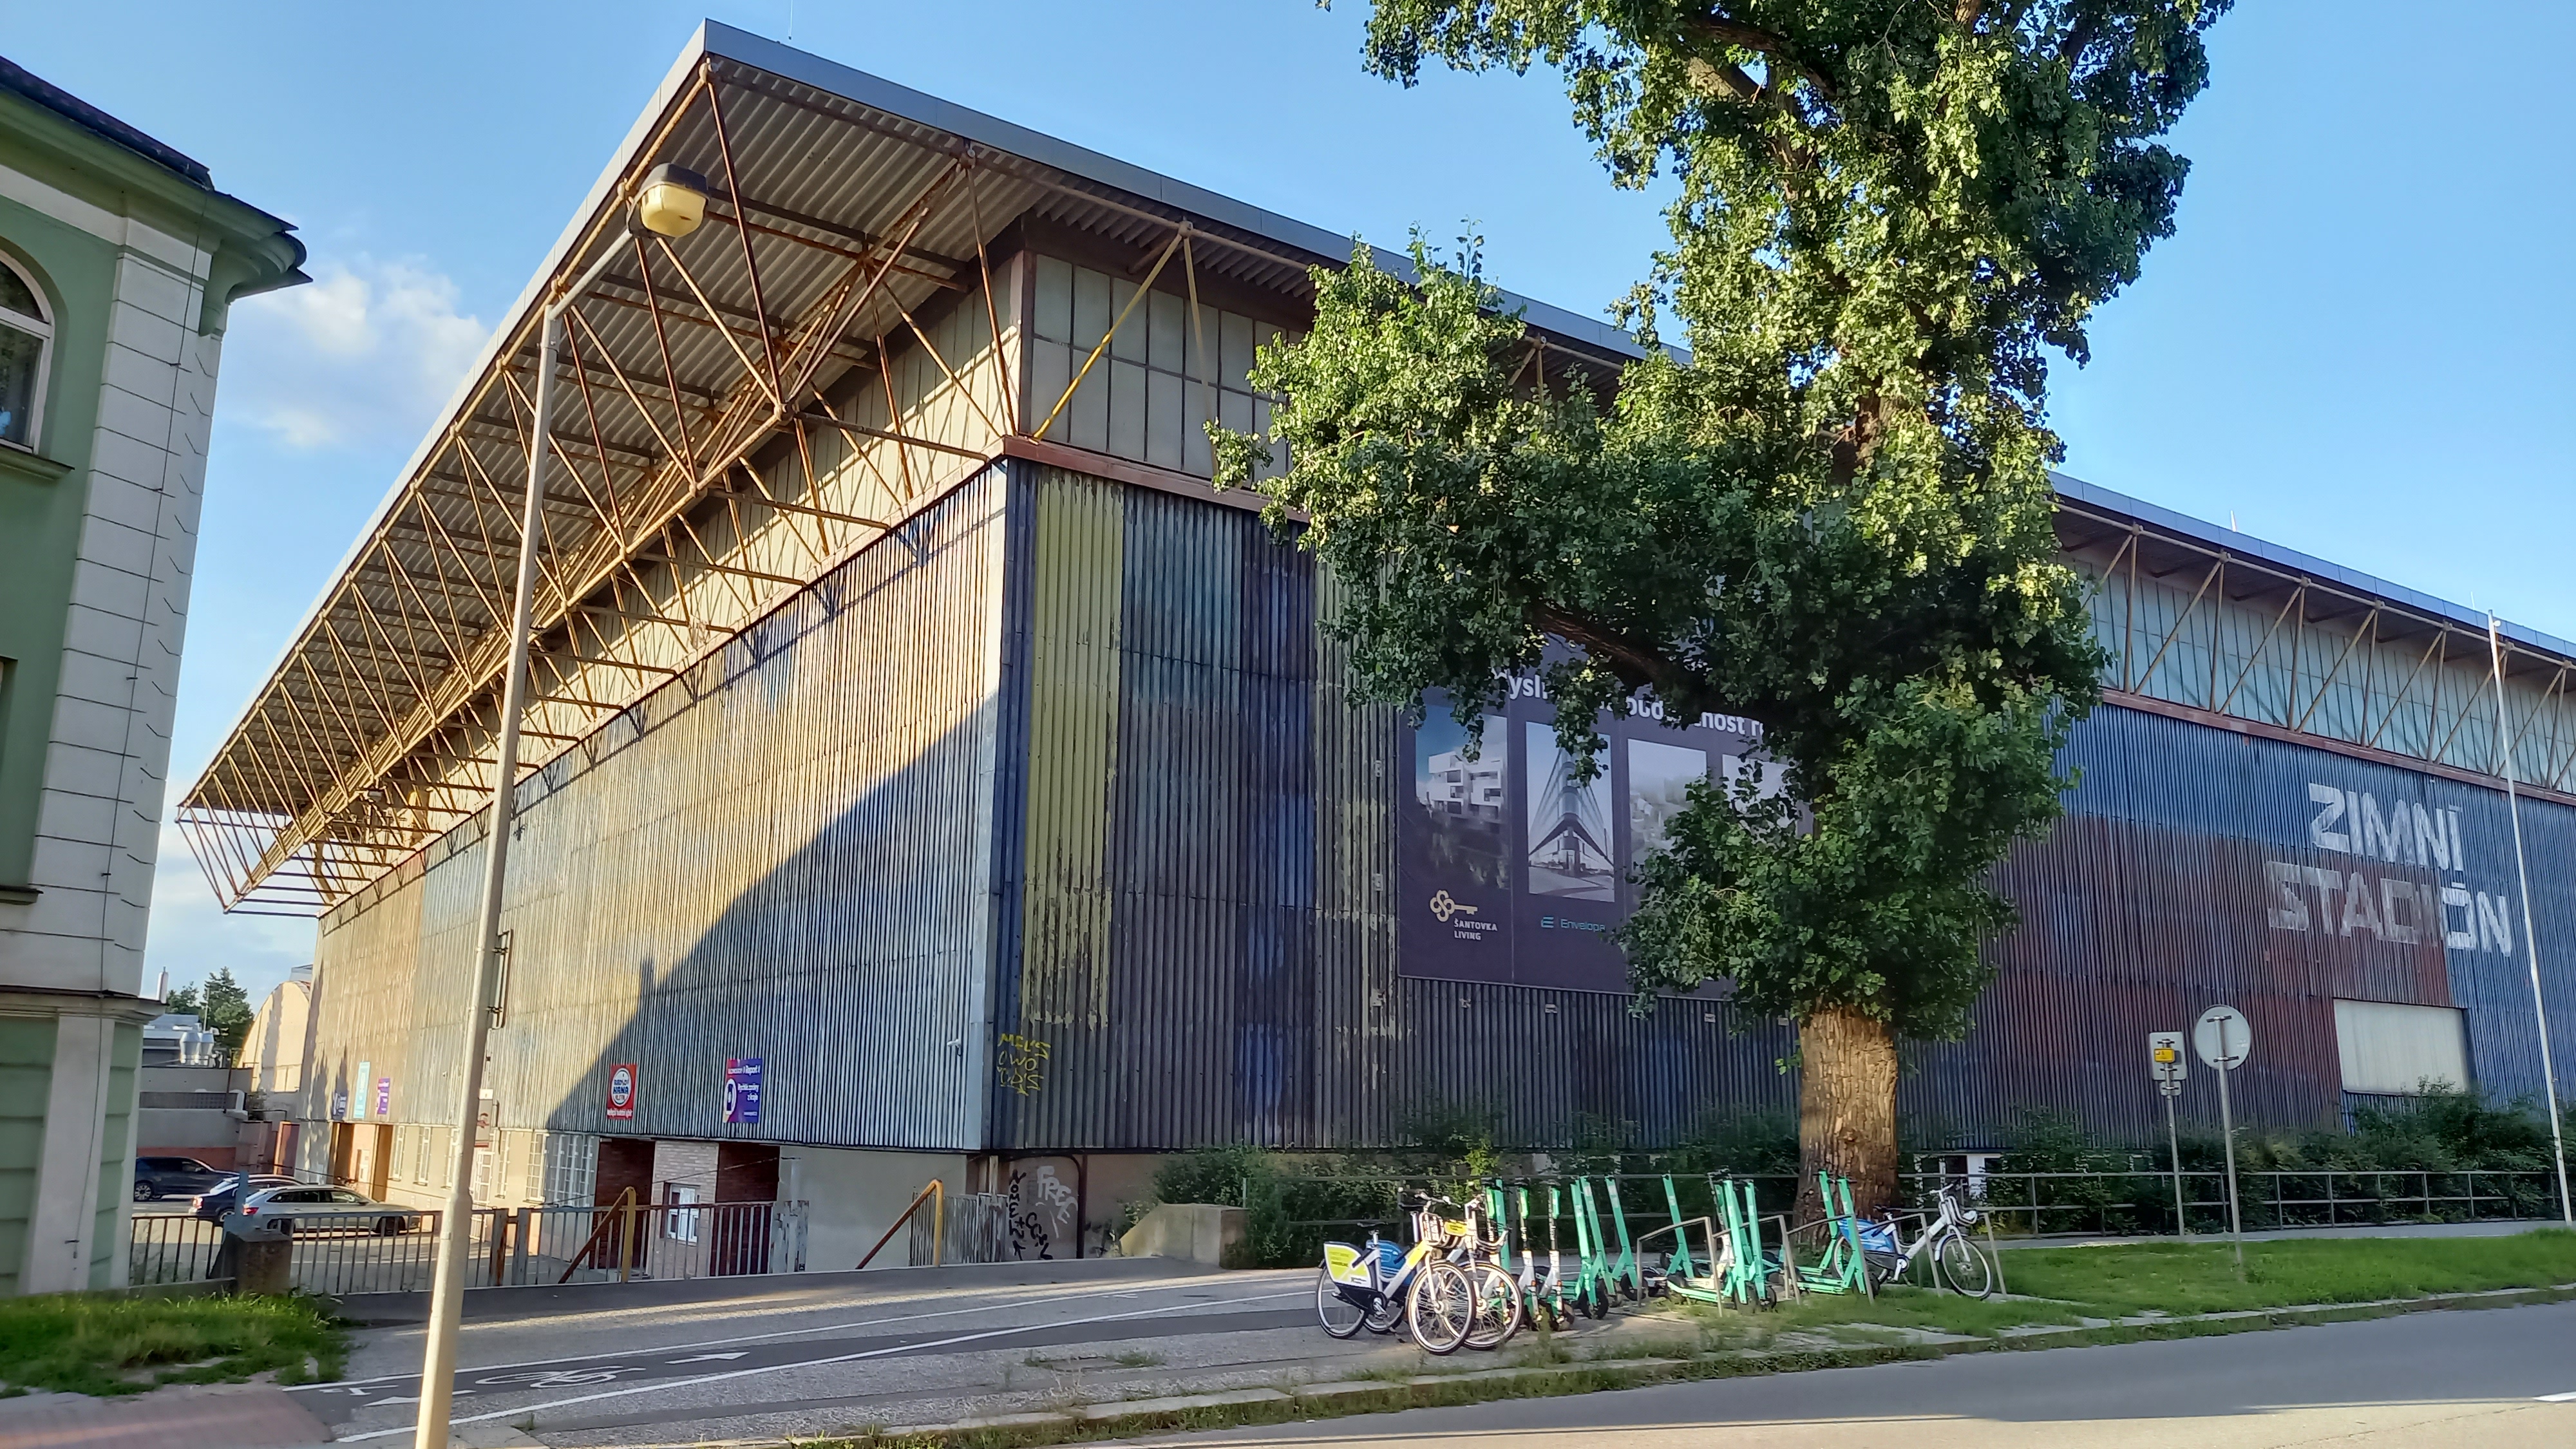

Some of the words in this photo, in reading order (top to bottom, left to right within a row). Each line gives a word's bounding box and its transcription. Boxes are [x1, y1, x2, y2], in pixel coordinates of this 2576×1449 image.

[2308, 782, 2463, 871] ZIMNÍ
[1454, 918, 1497, 931] ŠANTOVKA
[1454, 931, 1481, 940] LIVING
